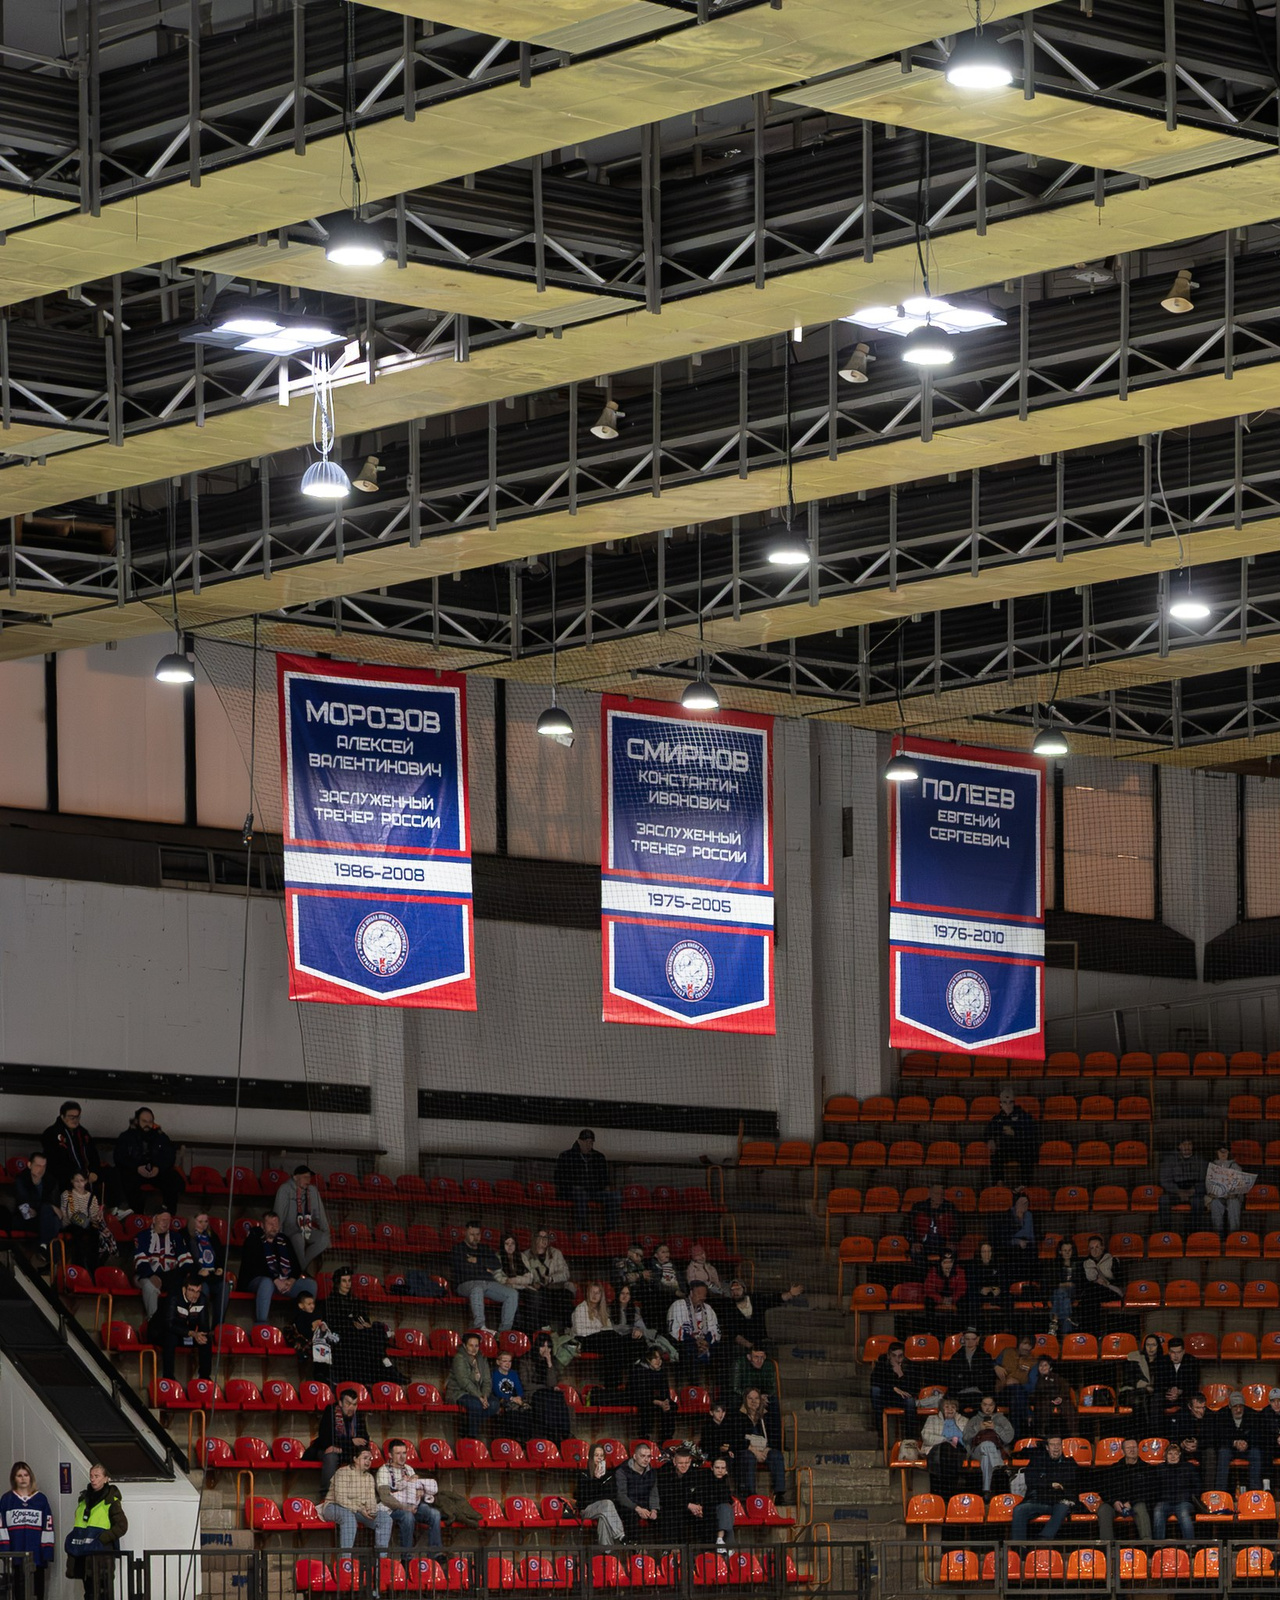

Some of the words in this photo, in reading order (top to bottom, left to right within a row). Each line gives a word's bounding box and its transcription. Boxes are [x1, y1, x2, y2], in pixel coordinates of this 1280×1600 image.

[305, 699, 441, 734] МОРОЗОВ
[336, 735, 414, 755] АЛЕКСЕЙ
[626, 737, 750, 774] СМИРНОВ
[309, 753, 442, 778] ВАЛЕНТИНОВИЧ
[638, 770, 739, 795] КОНСТАНТИН
[921, 777, 1016, 810] ПОЛЕЕВ
[318, 789, 435, 811] ЗАСЛУЖЕННЫЙ
[648, 790, 730, 812] ИВАНОВИЧ
[313, 807, 374, 824] ТРЕНЕР
[381, 814, 441, 829] РОССИИ
[937, 809, 1001, 829] ЕВГЕНИЙ
[636, 822, 742, 846] ЗАСЛУЖЕННЫЙ
[929, 826, 1010, 849] СЕРГЕЕВИЧ
[631, 839, 686, 857] ТРЕНЕР
[692, 846, 747, 864] РОССИИ
[334, 862, 425, 882] 1986-2008
[647, 892, 732, 913] 1975-2005
[933, 924, 1005, 944] 1976-2010
